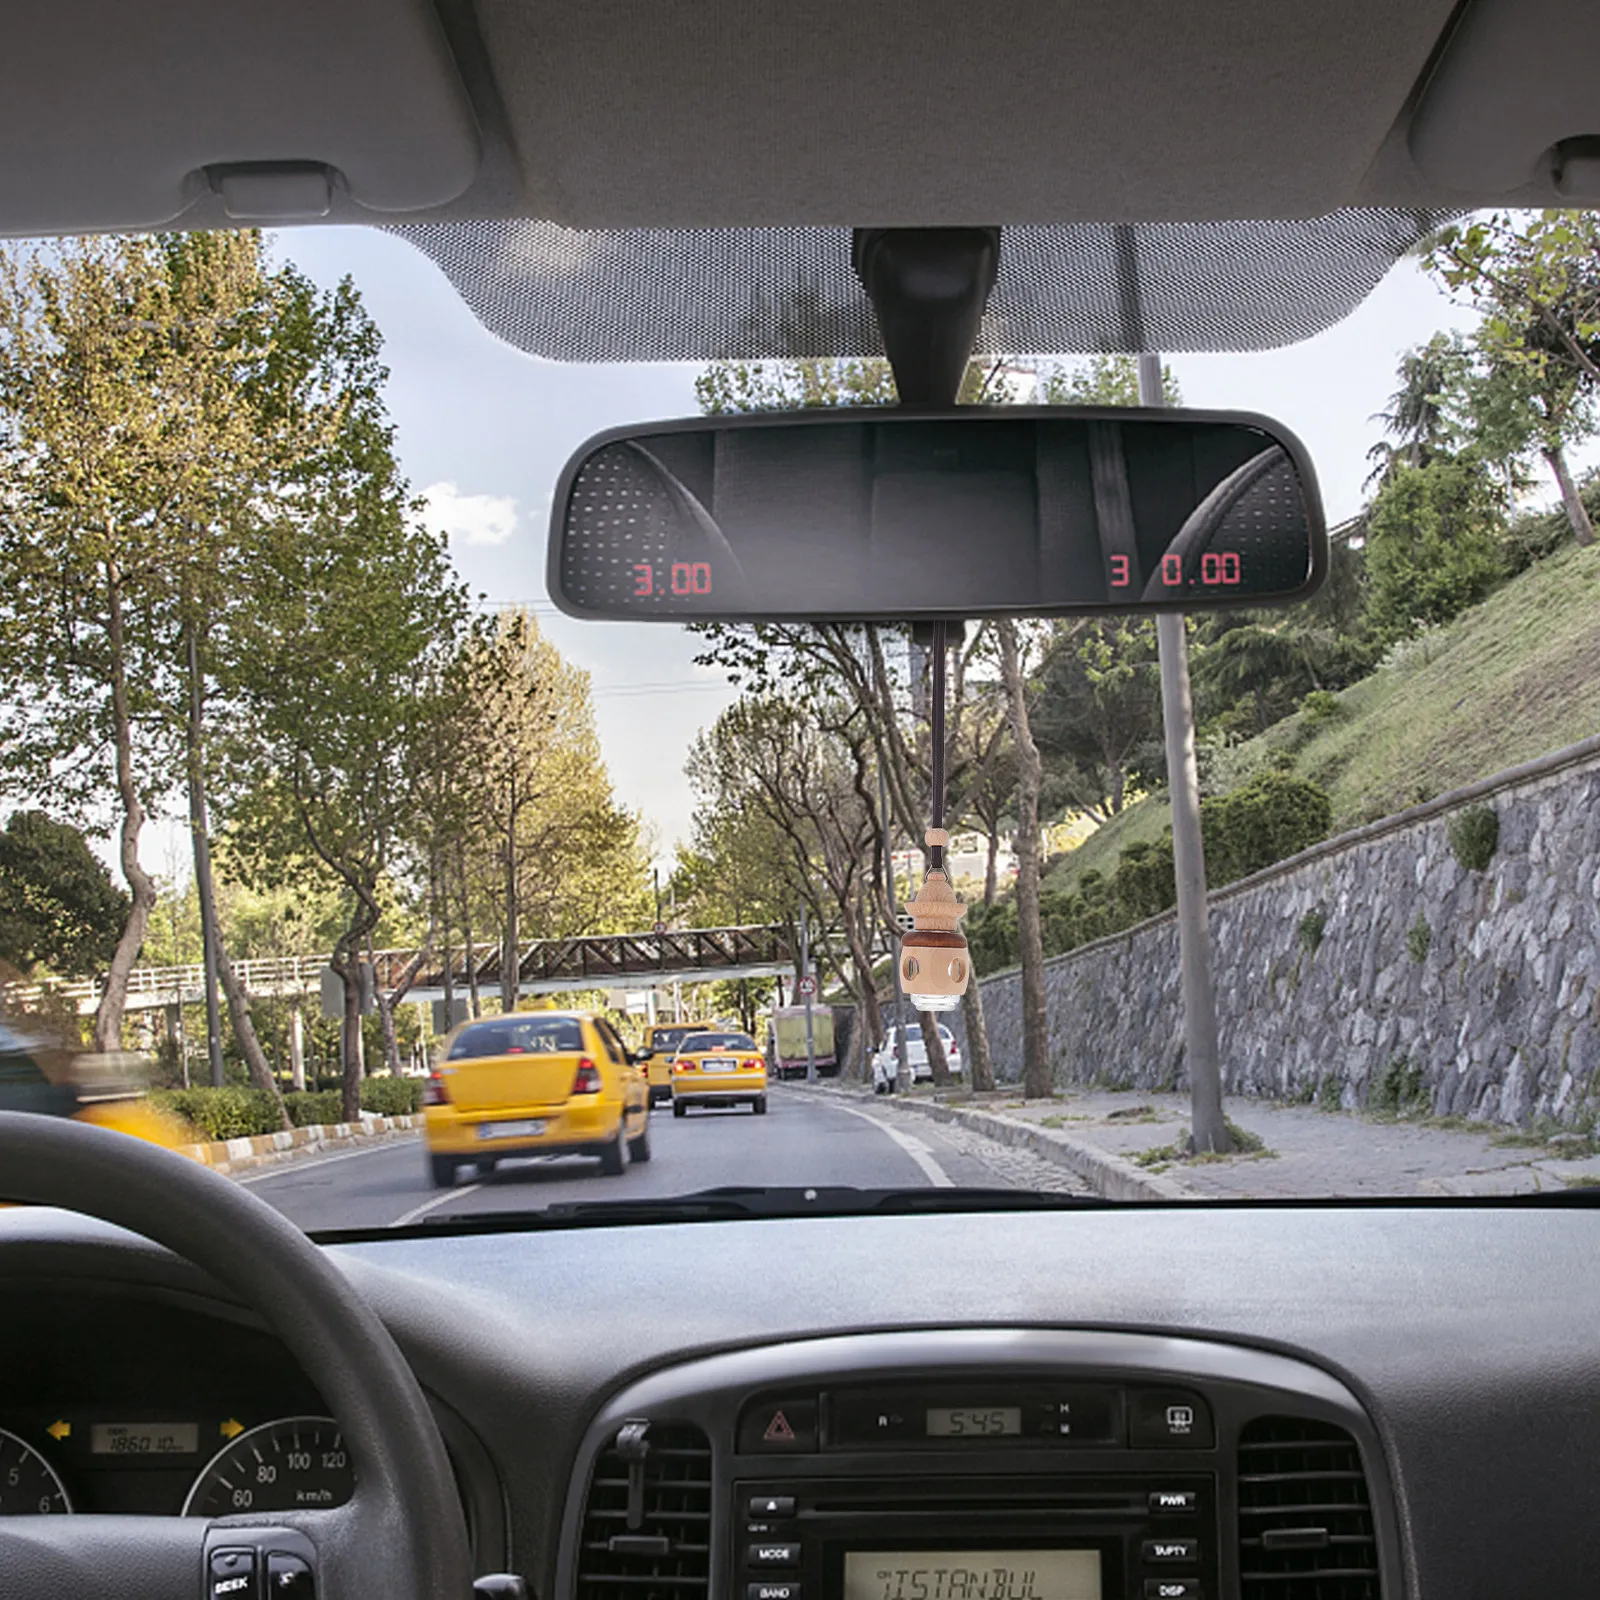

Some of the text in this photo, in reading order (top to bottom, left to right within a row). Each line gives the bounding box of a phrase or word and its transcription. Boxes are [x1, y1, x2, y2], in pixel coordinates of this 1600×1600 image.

[632, 561, 711, 596] 3.00
[948, 1410, 1005, 1434] 5:45
[287, 1452, 312, 1470] 100
[321, 1451, 346, 1468] 120
[7, 1467, 20, 1487] 5
[256, 1465, 277, 1484] 80
[38, 1495, 51, 1513] 6
[231, 1488, 253, 1507] 60
[295, 1488, 332, 1502] km/h
[1159, 1494, 1186, 1507] PWR
[759, 1548, 790, 1561] MODE
[759, 1587, 790, 1599] BAND
[891, 1568, 1042, 1600] ISTANBUL
[1158, 1584, 1186, 1598] DISP
